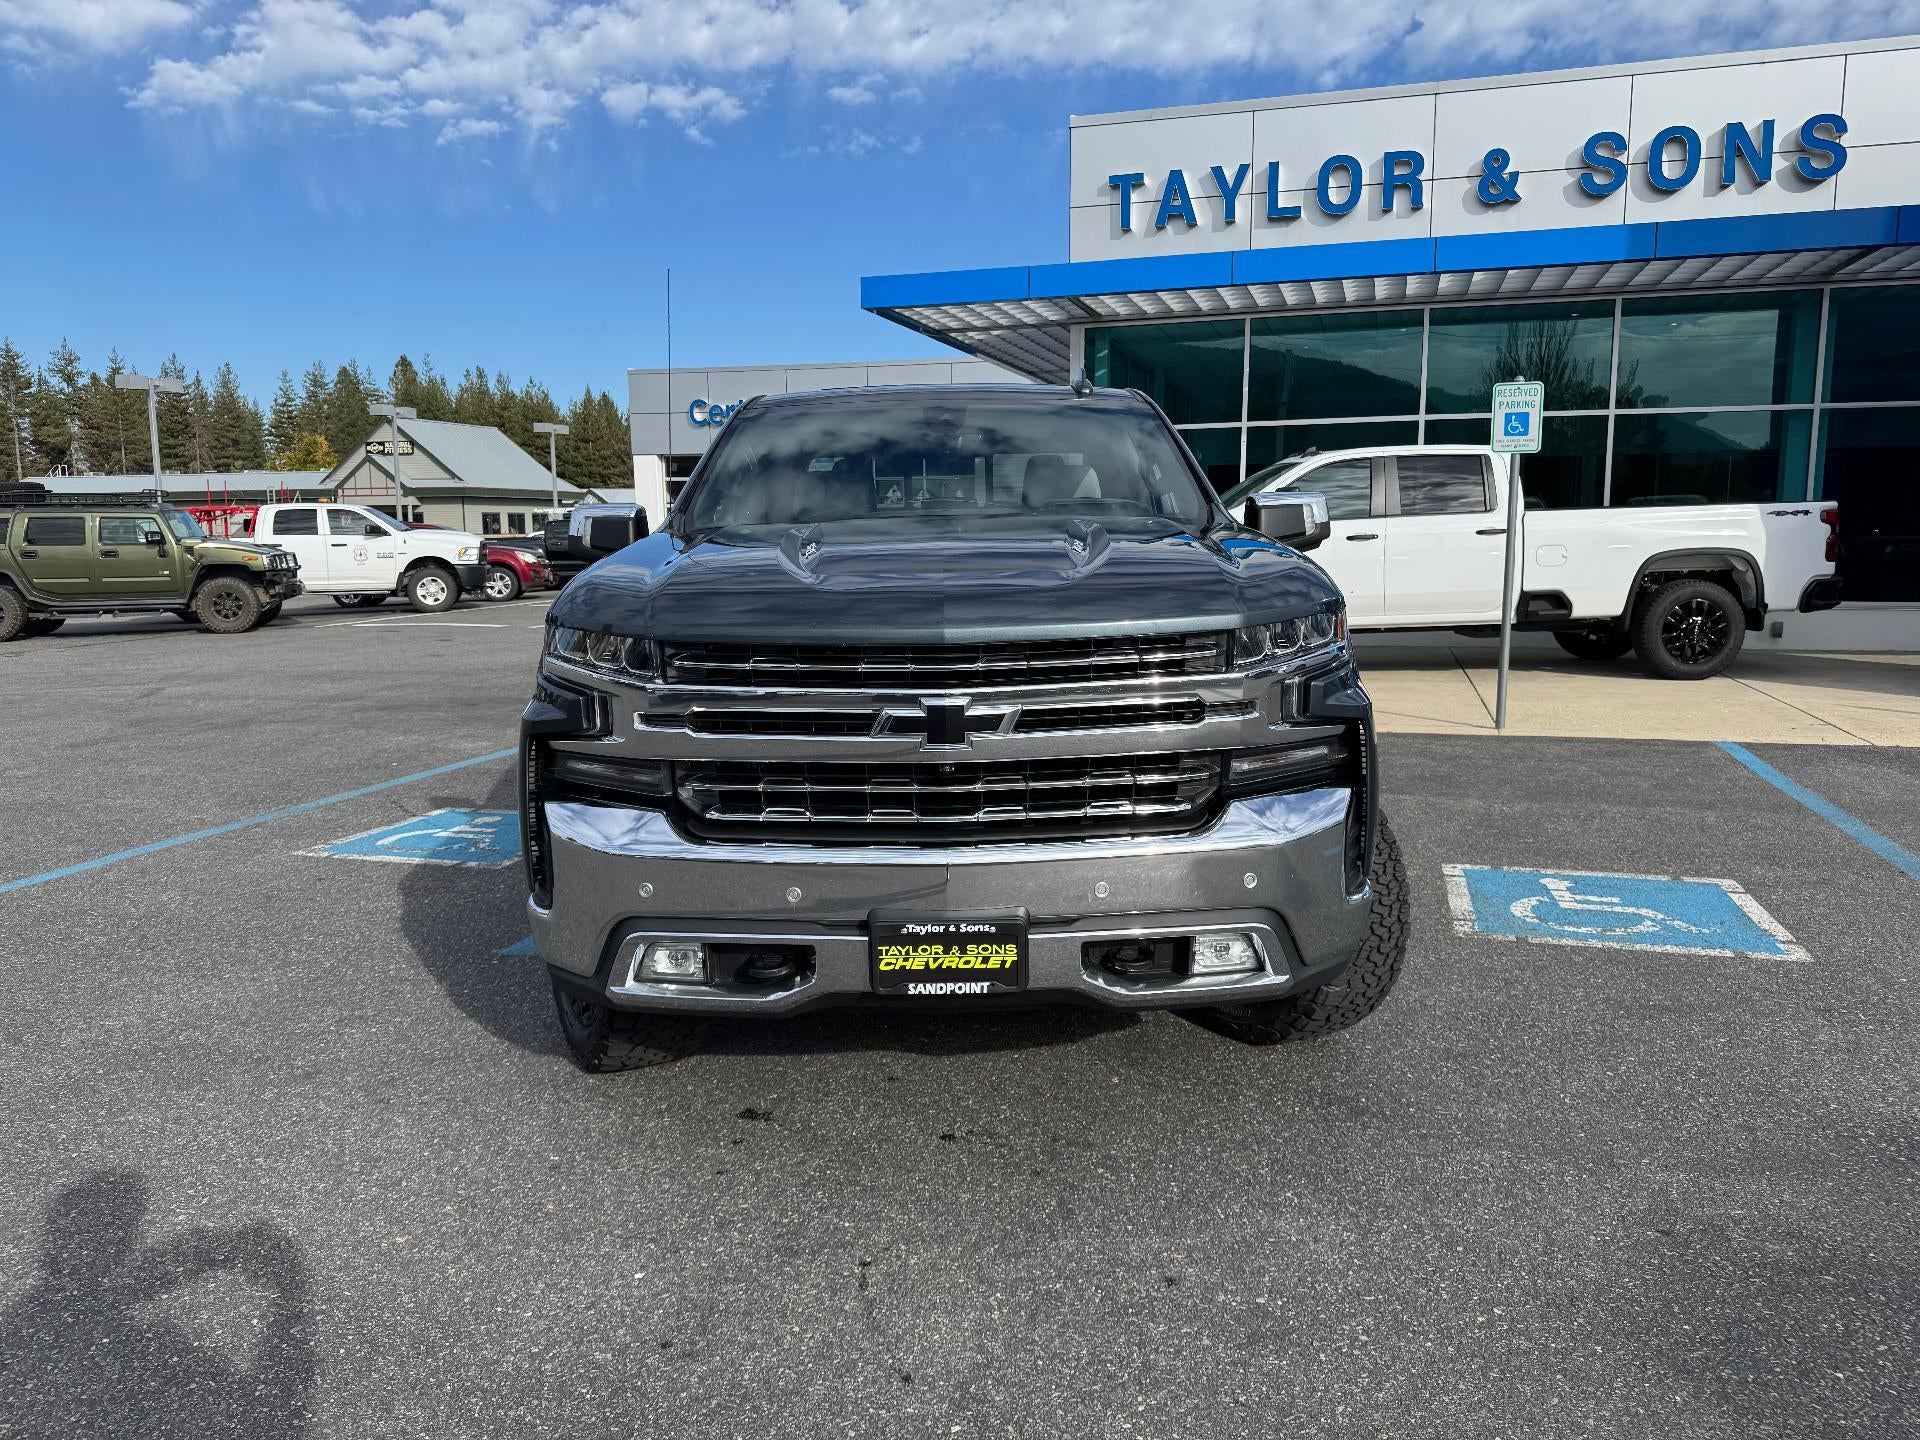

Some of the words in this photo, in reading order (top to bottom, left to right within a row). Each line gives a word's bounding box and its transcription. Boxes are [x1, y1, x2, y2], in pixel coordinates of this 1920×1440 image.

[1108, 150, 1425, 231] TAYLOR
[1476, 147, 1522, 205] &
[1579, 113, 1848, 199] SONS
[1497, 388, 1538, 397] RESERVED
[1499, 400, 1536, 409] PARKING
[906, 924, 945, 935] Taylor
[960, 923, 990, 932] Sons
[878, 945, 944, 956] TAYLOR
[949, 945, 961, 957] &
[966, 944, 1017, 955] SONS
[879, 956, 1017, 971] CHEVROLET
[907, 982, 990, 995] SANDPOINT
